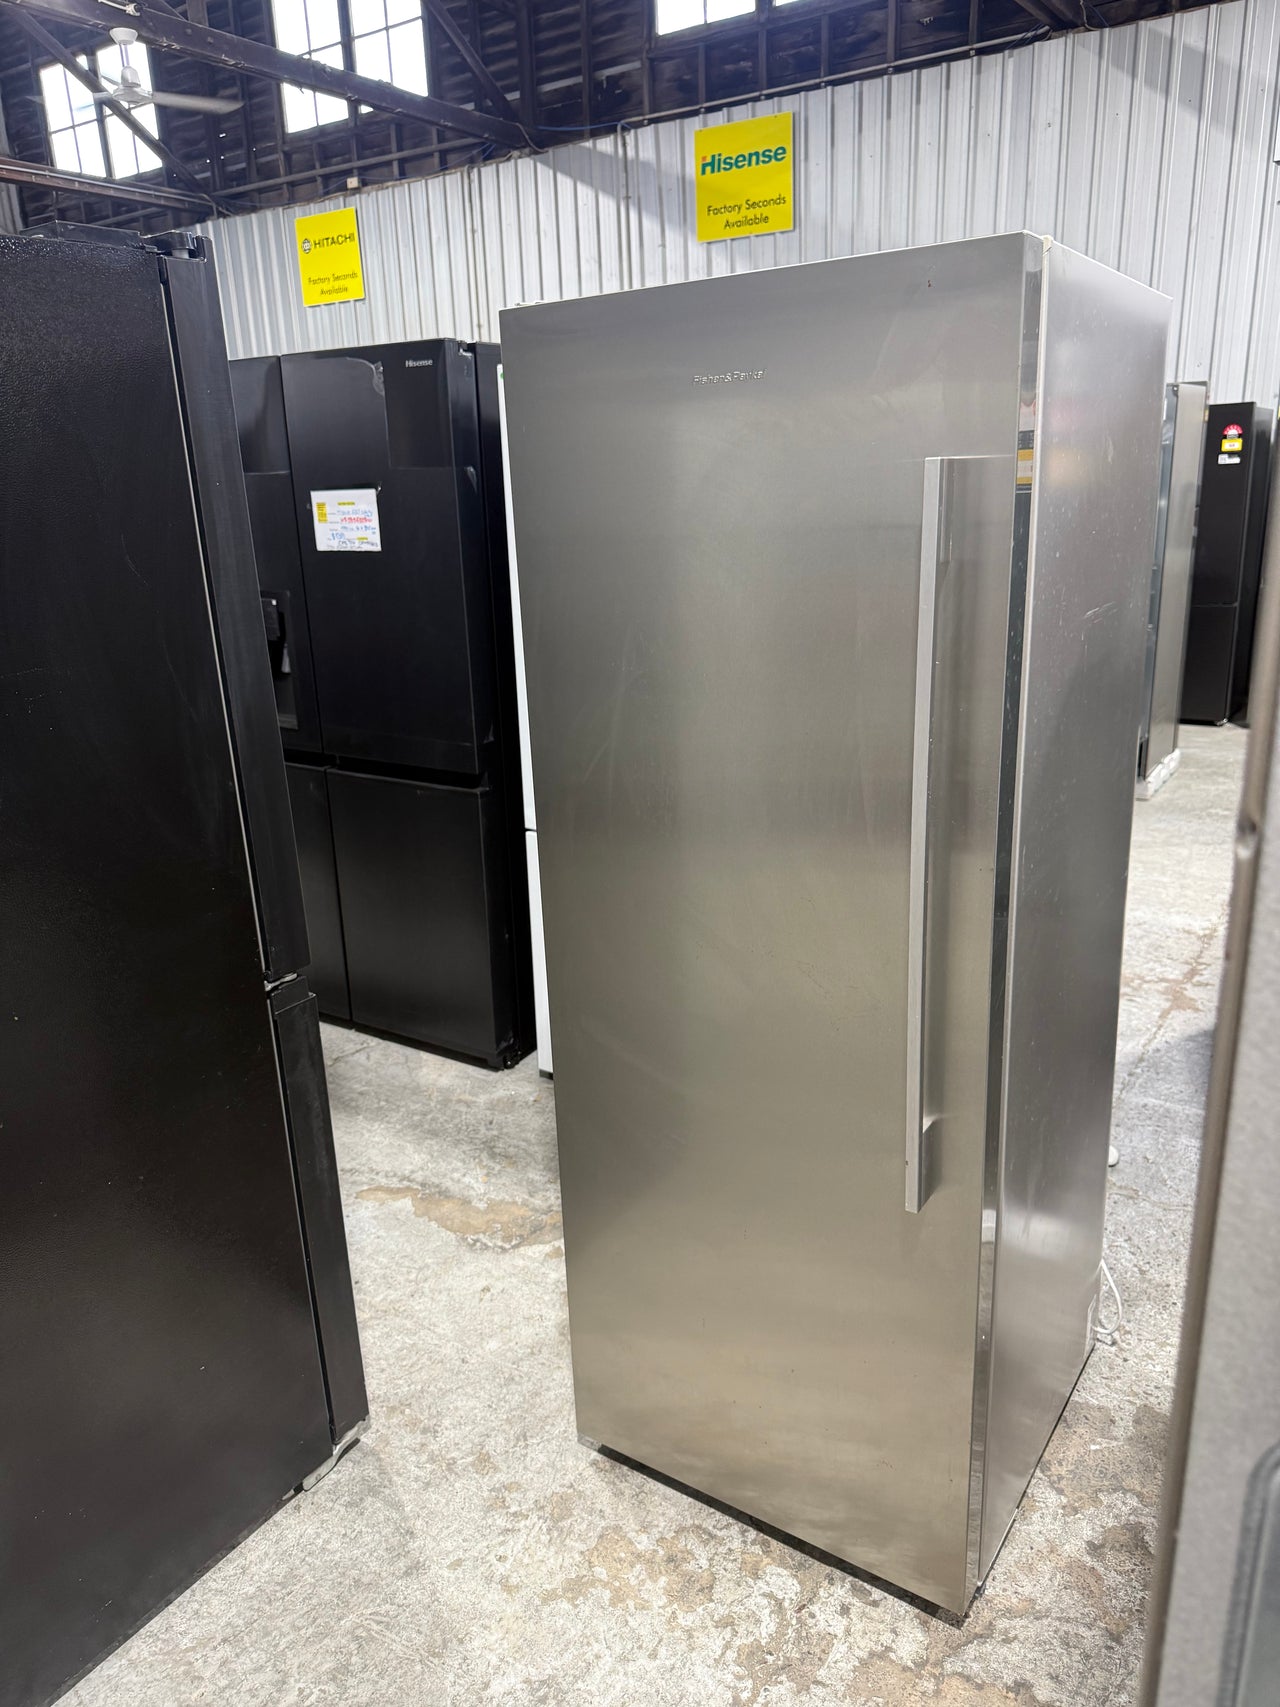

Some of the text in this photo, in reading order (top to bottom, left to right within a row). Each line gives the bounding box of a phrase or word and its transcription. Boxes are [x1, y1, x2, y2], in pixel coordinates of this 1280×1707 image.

[701, 146, 787, 176] Hisense
[707, 194, 787, 217] Factory Seconds
[724, 213, 769, 230] Available
[313, 232, 355, 249] HITACHI
[308, 270, 358, 286] Factory Seconds
[405, 359, 433, 368] Hisense
